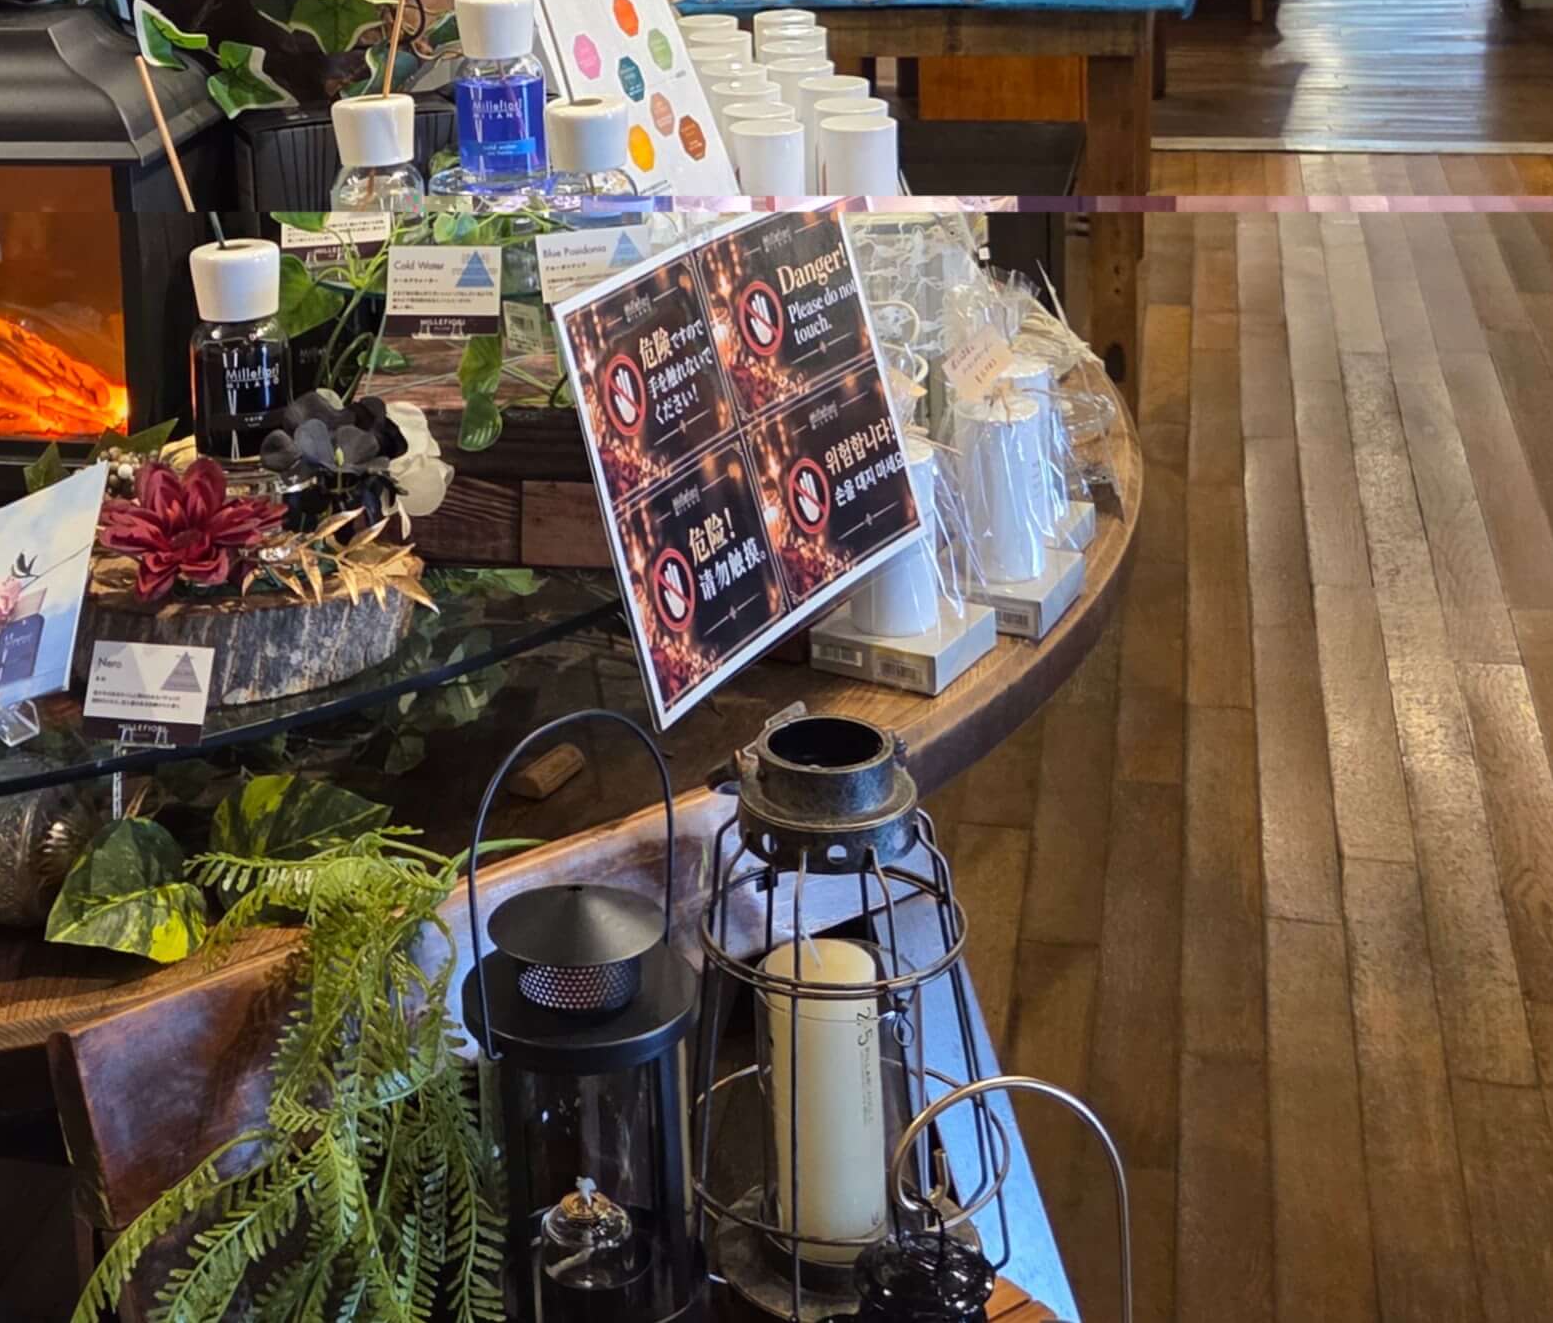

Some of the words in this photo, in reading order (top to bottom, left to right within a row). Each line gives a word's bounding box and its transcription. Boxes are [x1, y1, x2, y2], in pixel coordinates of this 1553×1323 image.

[394, 260, 415, 271] Cold
[418, 260, 445, 271] Water
[776, 242, 847, 295] Danger!
[787, 296, 824, 324] Please
[824, 287, 838, 306] do
[839, 278, 859, 299] not
[639, 319, 704, 372] 危険ですので
[794, 313, 832, 345] touch.
[226, 362, 279, 380] Millefiori
[648, 347, 713, 399] 手を触れないで
[655, 383, 699, 425] ください!
[825, 417, 897, 476] 위험합니다!
[835, 479, 856, 507] 손을
[855, 466, 877, 491] 대지
[689, 507, 736, 567] 危险!
[698, 537, 766, 601] 请勿触摸。
[97, 657, 122, 669] Nero
